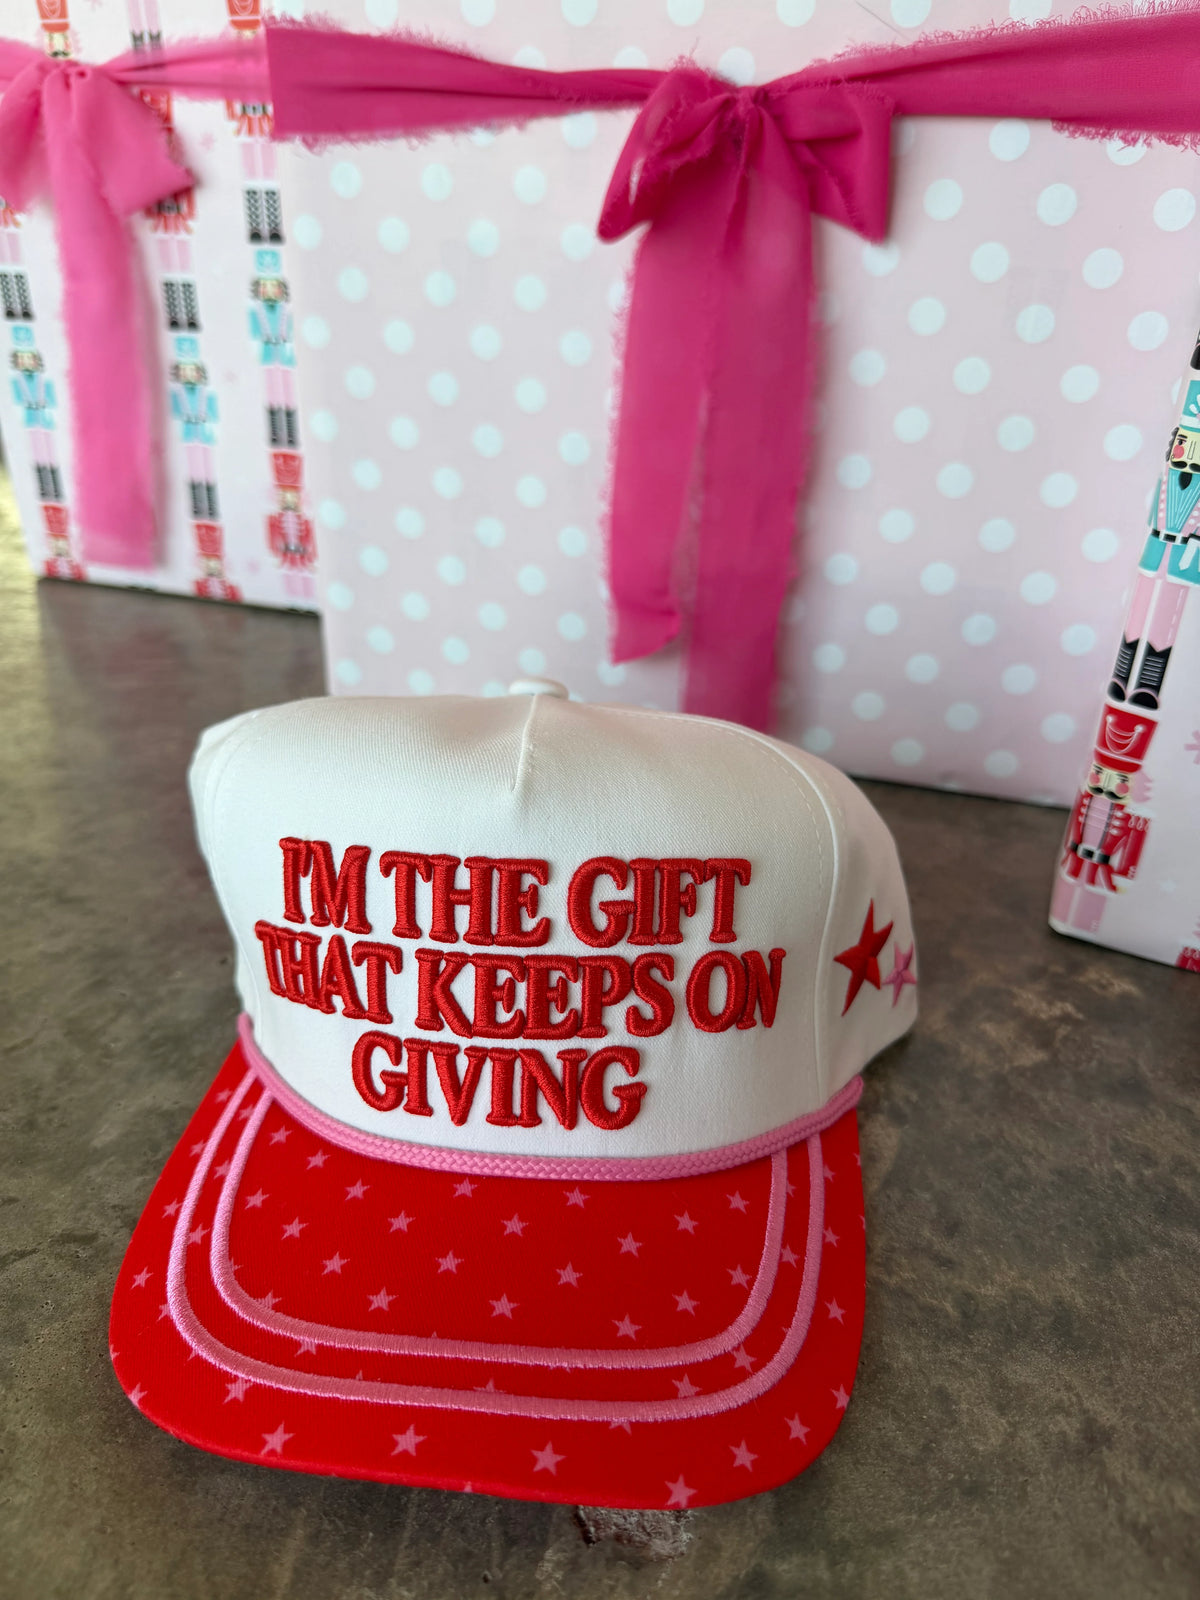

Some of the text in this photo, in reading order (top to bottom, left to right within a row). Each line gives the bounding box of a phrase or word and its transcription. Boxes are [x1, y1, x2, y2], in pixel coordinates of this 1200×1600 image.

[279, 837, 751, 948] I'M THE GIFT
[255, 920, 787, 1040] THAT KEEPS ON
[352, 1030, 648, 1130] GIVING
